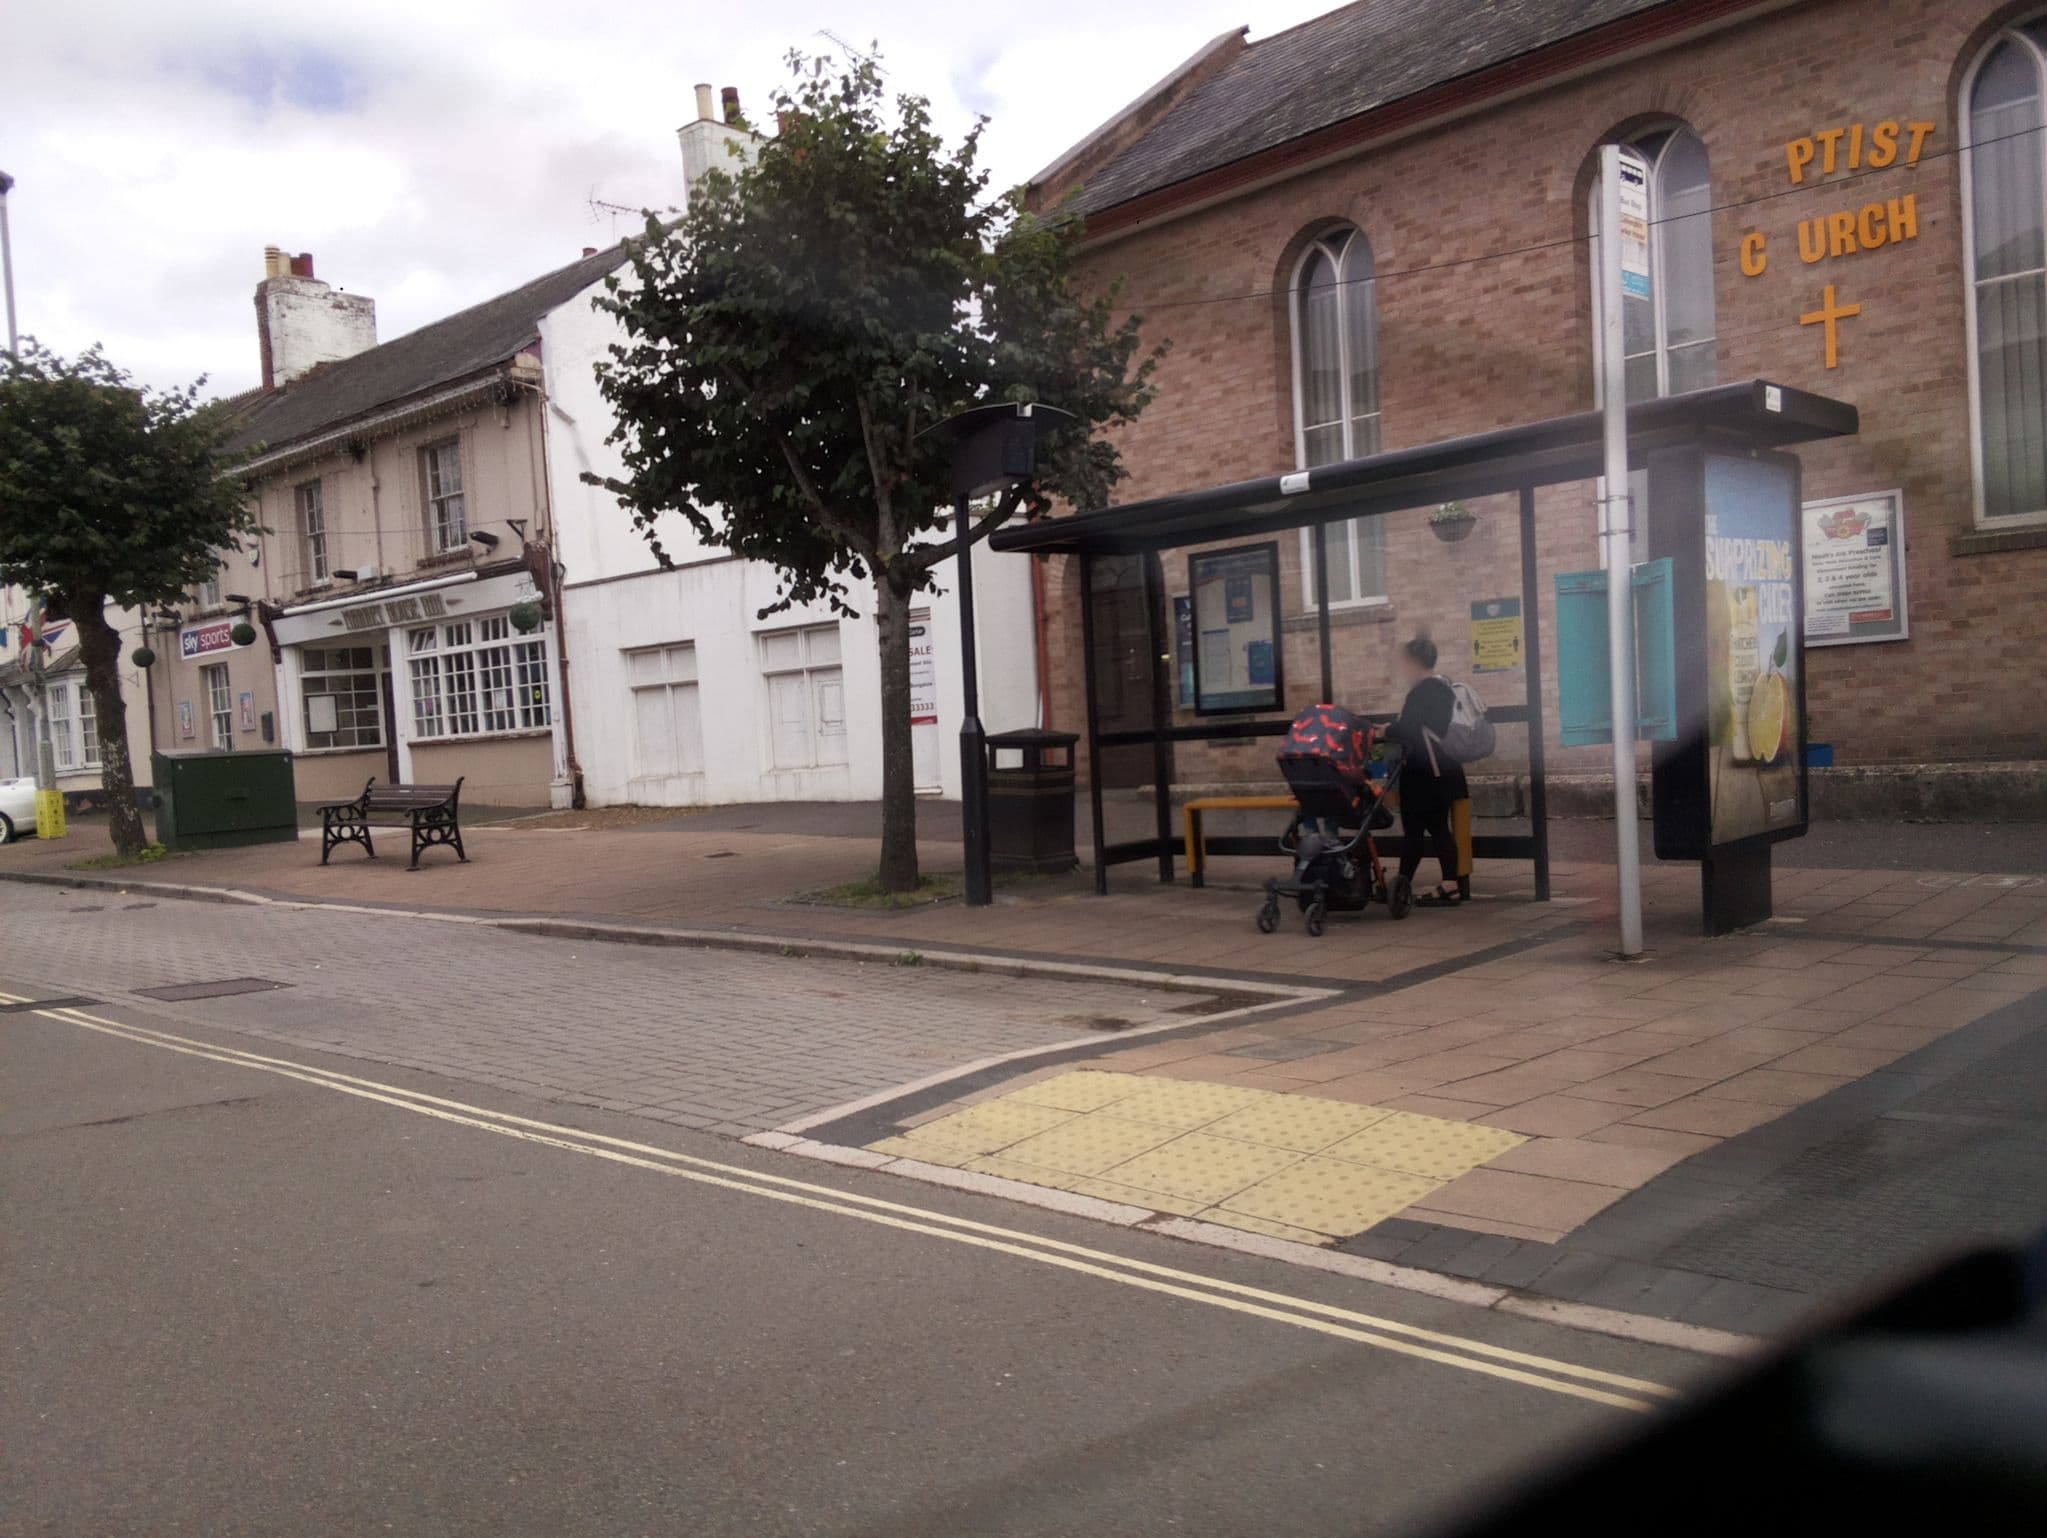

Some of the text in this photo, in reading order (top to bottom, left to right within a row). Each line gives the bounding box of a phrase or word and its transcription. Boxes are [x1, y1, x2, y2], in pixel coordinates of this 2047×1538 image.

[1786, 120, 1936, 184] PTIST
[184, 627, 230, 652] sky sports
[908, 645, 932, 657] SALE
